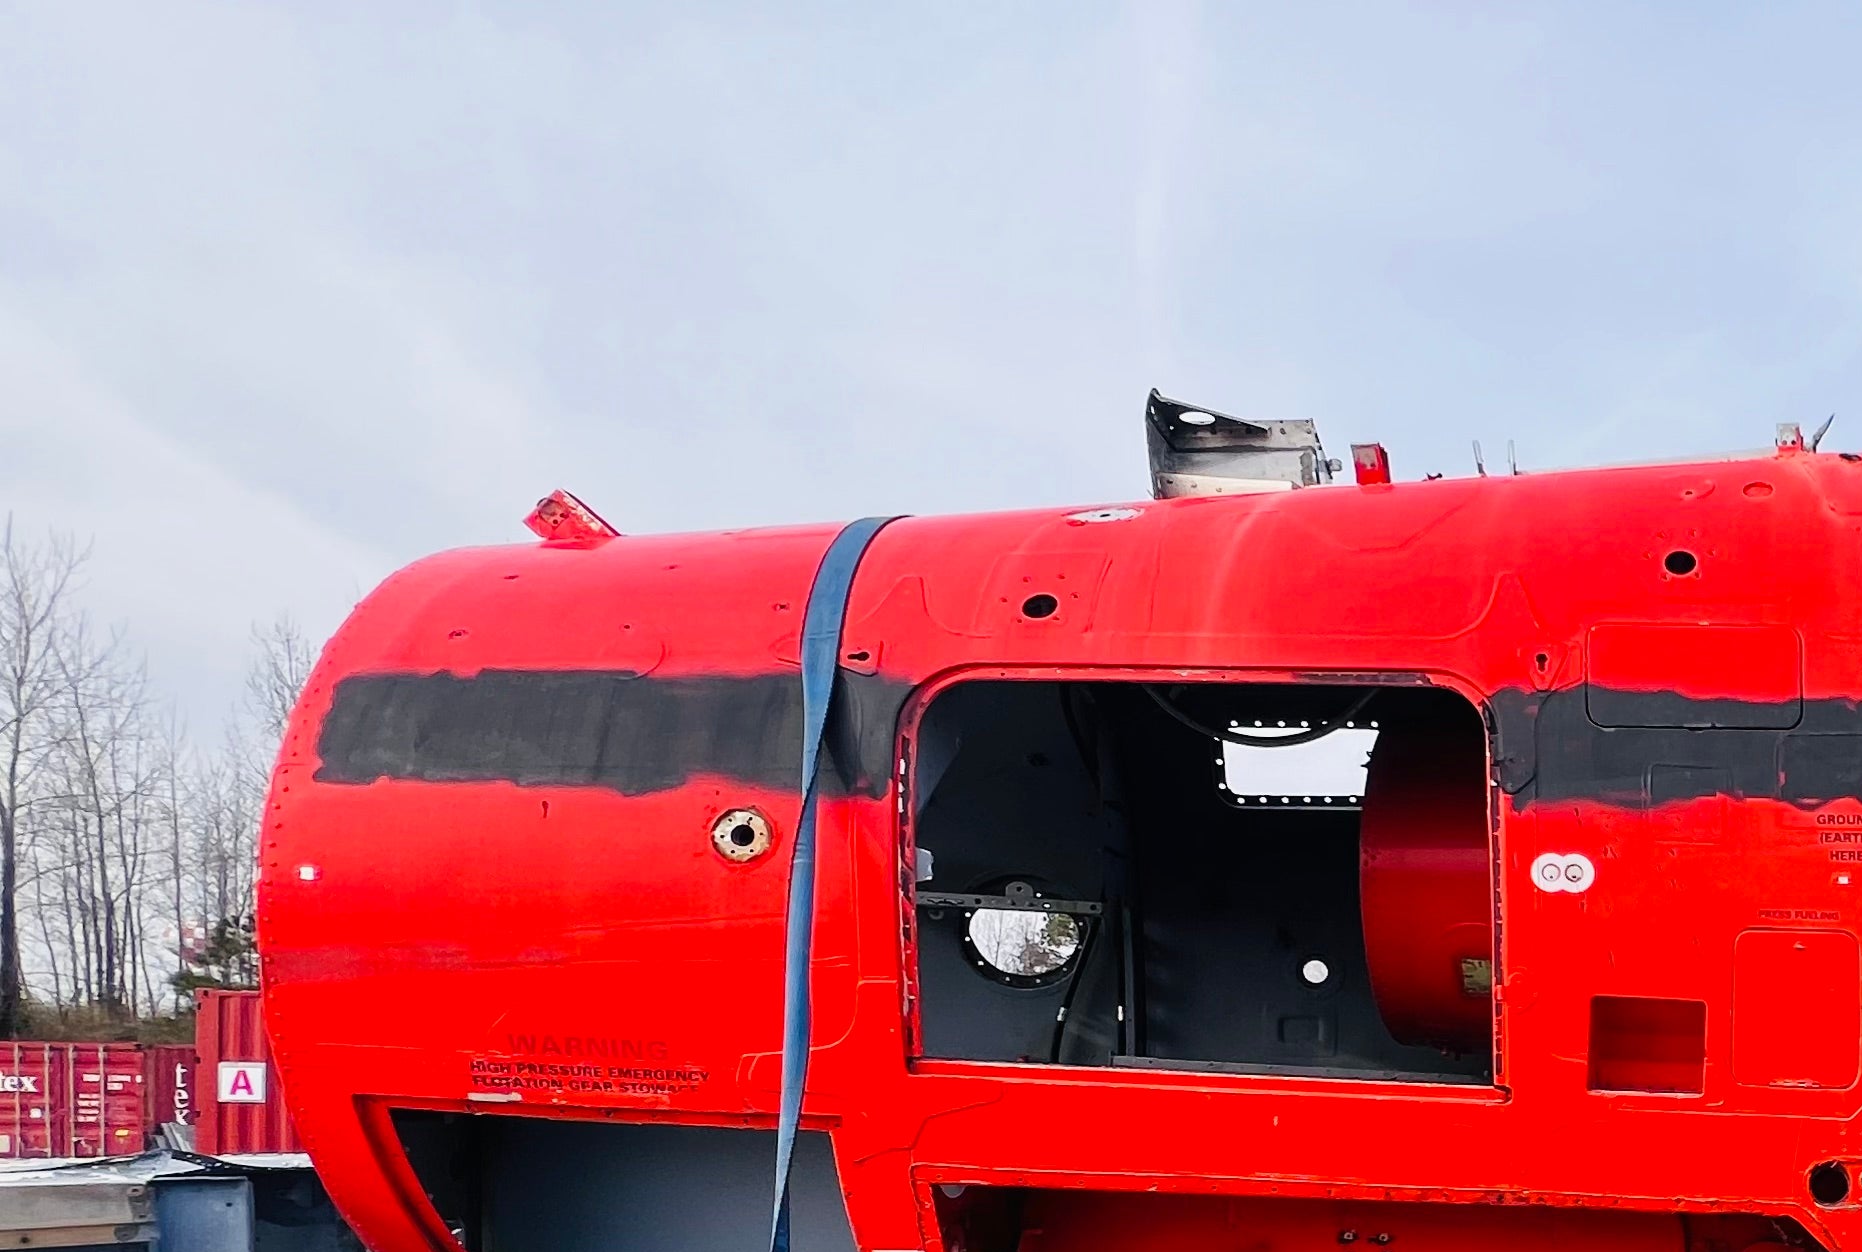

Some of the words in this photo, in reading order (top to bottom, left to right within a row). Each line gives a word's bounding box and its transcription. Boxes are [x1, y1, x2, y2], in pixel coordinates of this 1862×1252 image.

[507, 1033, 669, 1061] WARNING
[229, 1069, 254, 1096] A
[470, 1060, 512, 1074] HIGH
[516, 1061, 603, 1078] PRESSURE
[607, 1066, 711, 1083] EMERGENCY
[568, 1079, 614, 1092] GEAR
